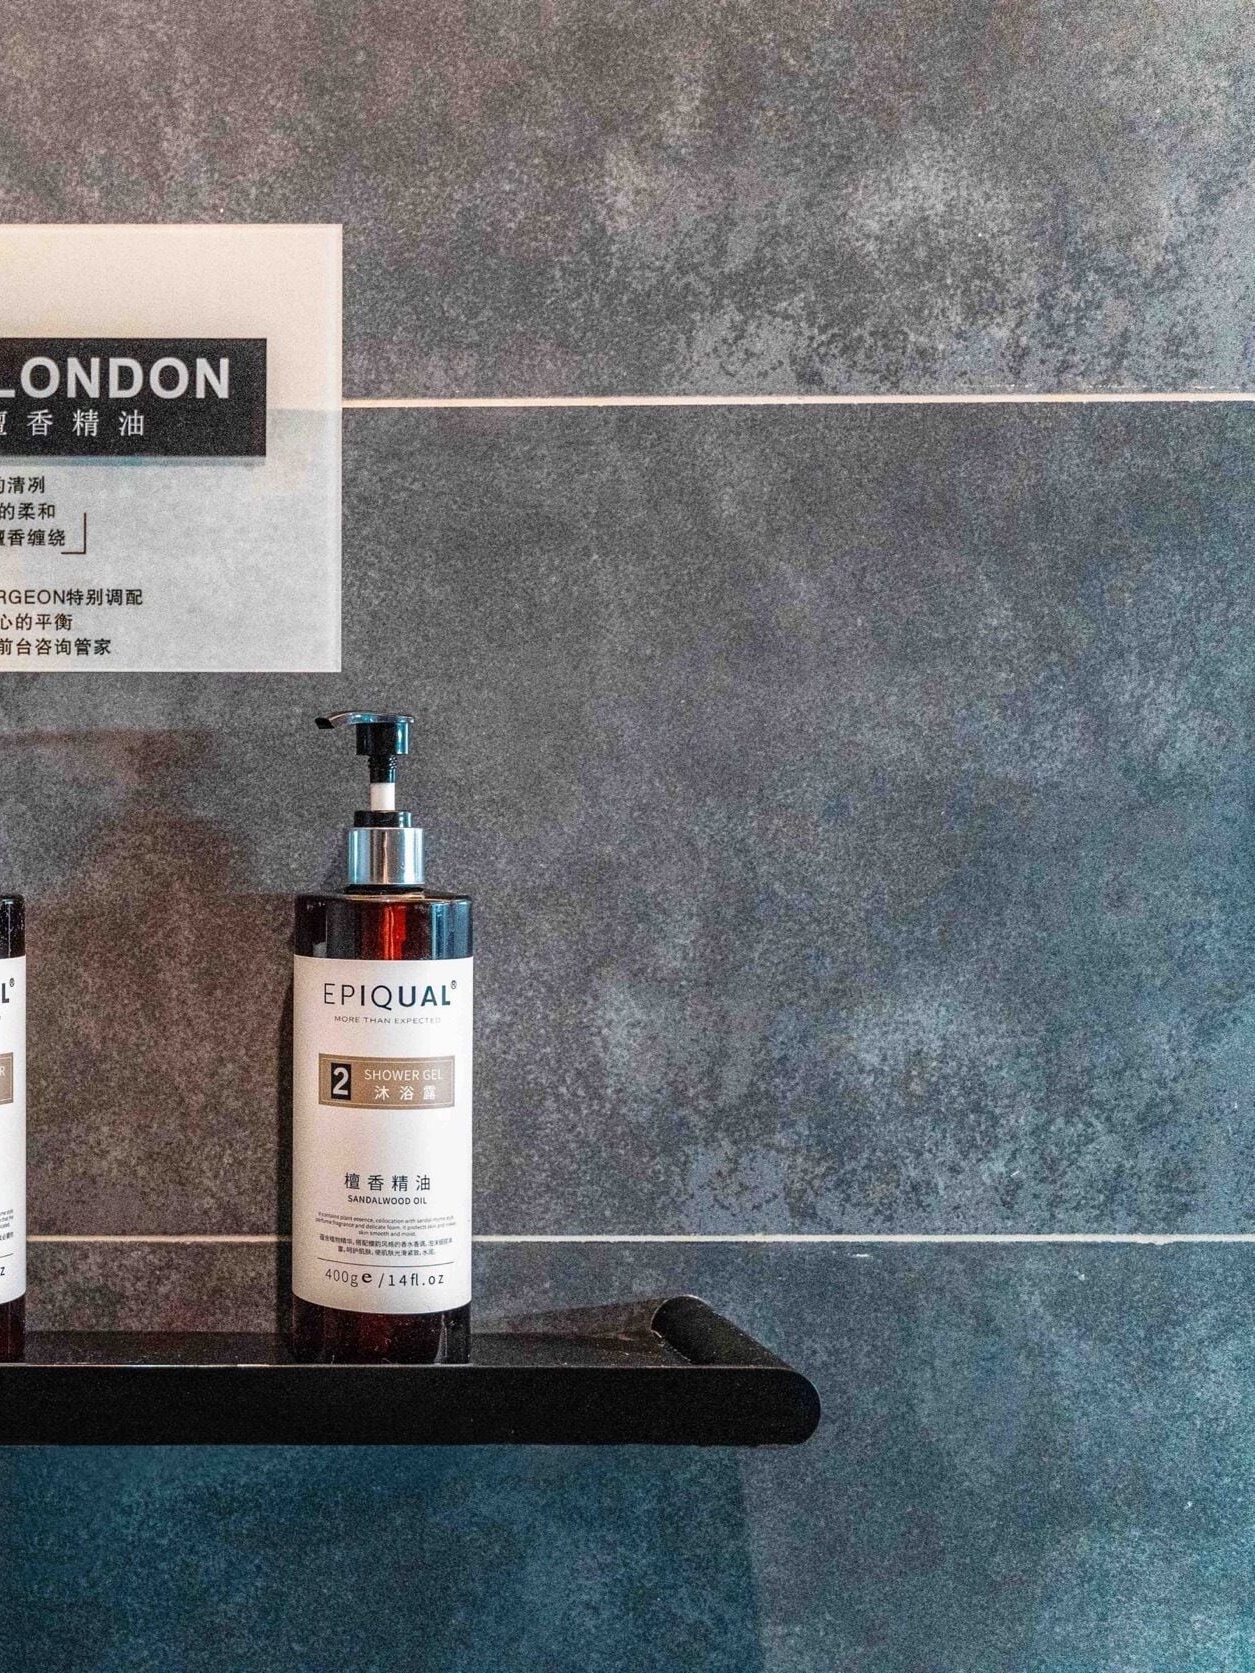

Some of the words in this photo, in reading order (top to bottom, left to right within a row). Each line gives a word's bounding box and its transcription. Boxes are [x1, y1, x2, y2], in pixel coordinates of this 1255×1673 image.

[334, 1015, 360, 1024] MORE
[394, 1017, 441, 1025] EXPECTED
[332, 1067, 349, 1096] 2
[364, 1069, 420, 1081] SHOWER
[422, 1069, 442, 1081] GEL
[374, 1085, 436, 1100] 沐浴露
[344, 1172, 430, 1192] 檀香精油
[347, 1194, 411, 1206] SANDALWOOD
[413, 1196, 427, 1205] OIL
